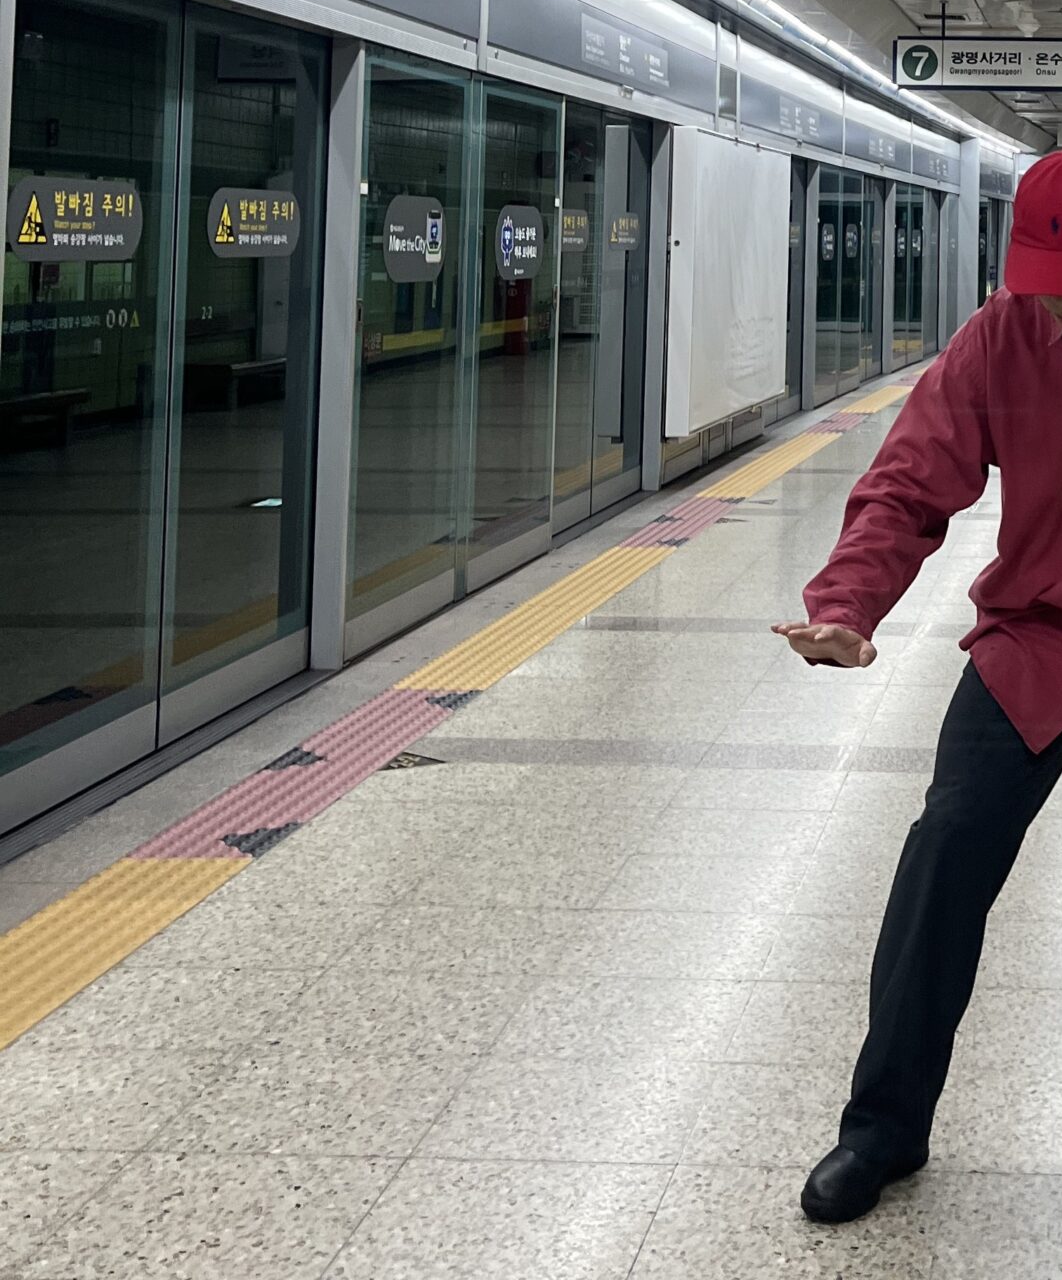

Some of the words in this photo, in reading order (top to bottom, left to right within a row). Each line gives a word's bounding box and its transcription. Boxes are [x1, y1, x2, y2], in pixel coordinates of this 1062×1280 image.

[912, 52, 929, 76] 7
[951, 51, 1021, 65] 광명사거리
[1035, 53, 1062, 66] 온수
[1036, 68, 1056, 76] Onsu
[54, 190, 93, 217] 발빠짐
[102, 193, 134, 217] 주의!
[239, 199, 267, 221] 발빠짐
[272, 201, 294, 221] 주의!
[389, 235, 406, 252] Move
[407, 238, 415, 251] the
[415, 235, 426, 254] City
